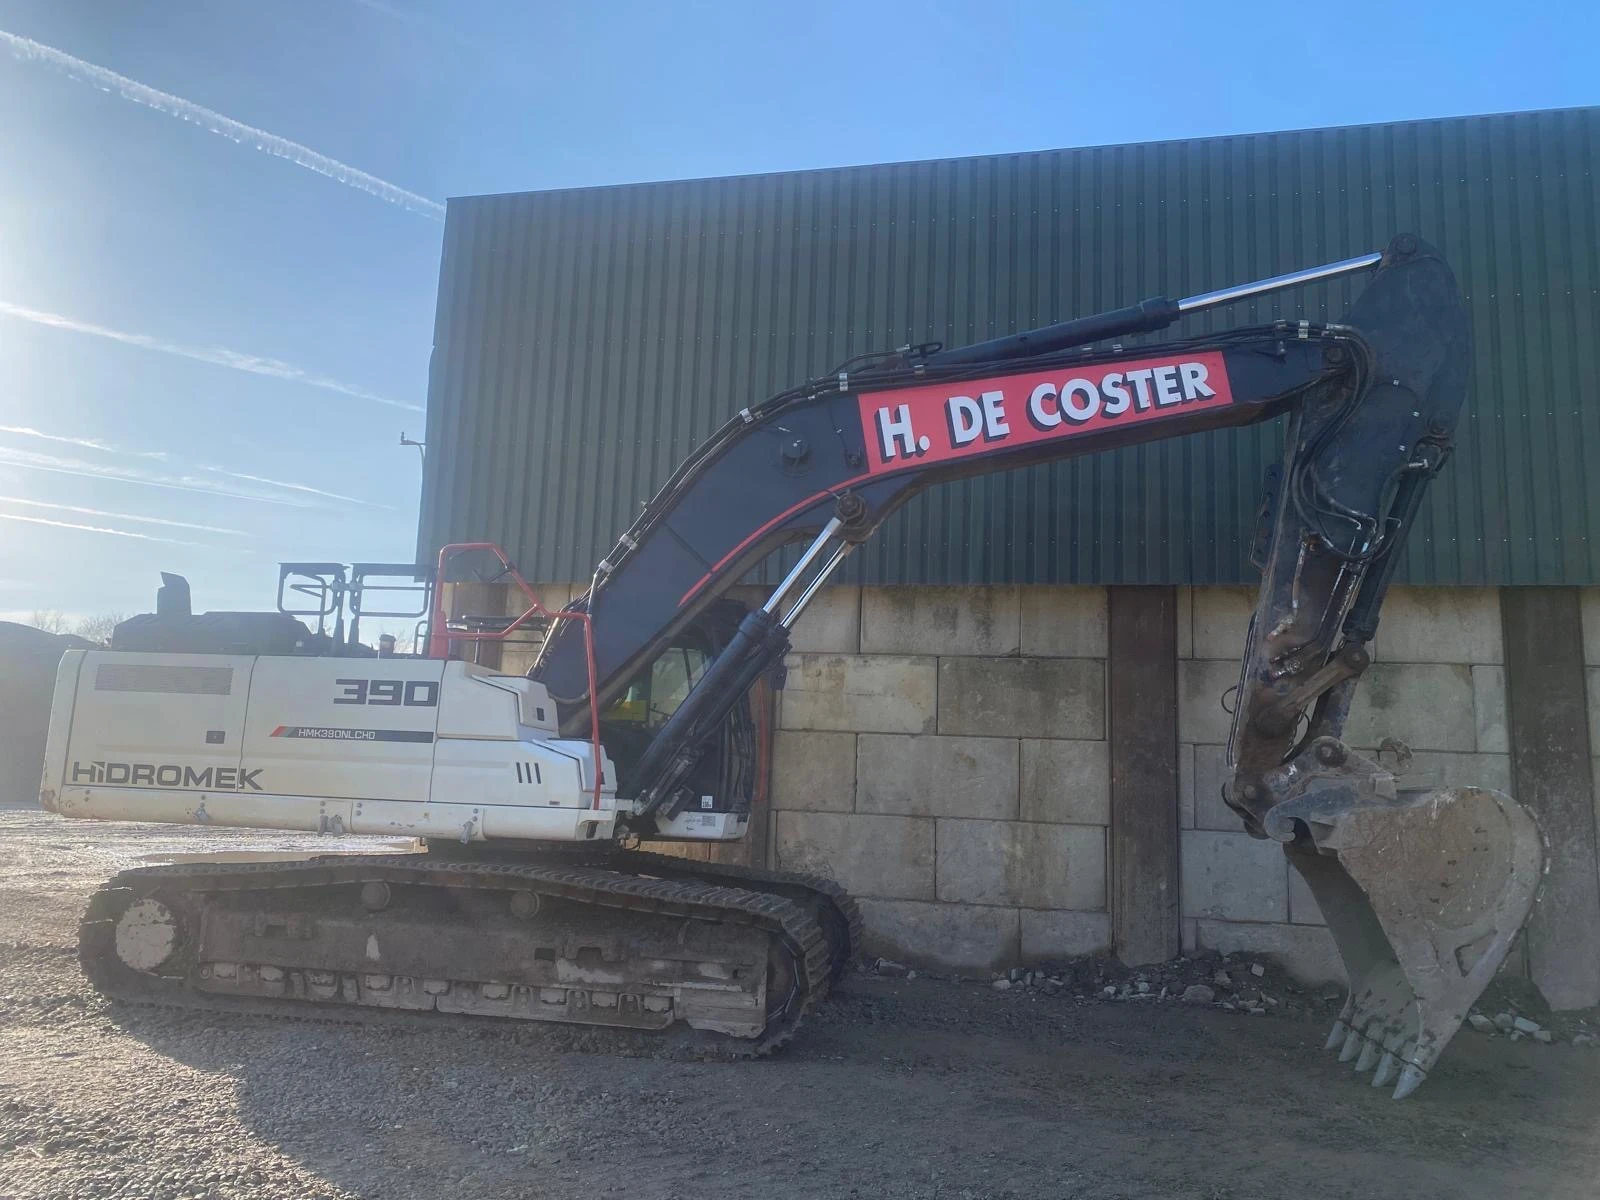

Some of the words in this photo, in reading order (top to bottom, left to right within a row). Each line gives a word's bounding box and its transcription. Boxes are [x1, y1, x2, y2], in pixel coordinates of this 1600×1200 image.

[876, 403, 931, 461] H.
[945, 390, 1010, 447] DE
[1028, 362, 1216, 429] COSTER
[333, 678, 439, 707] 390
